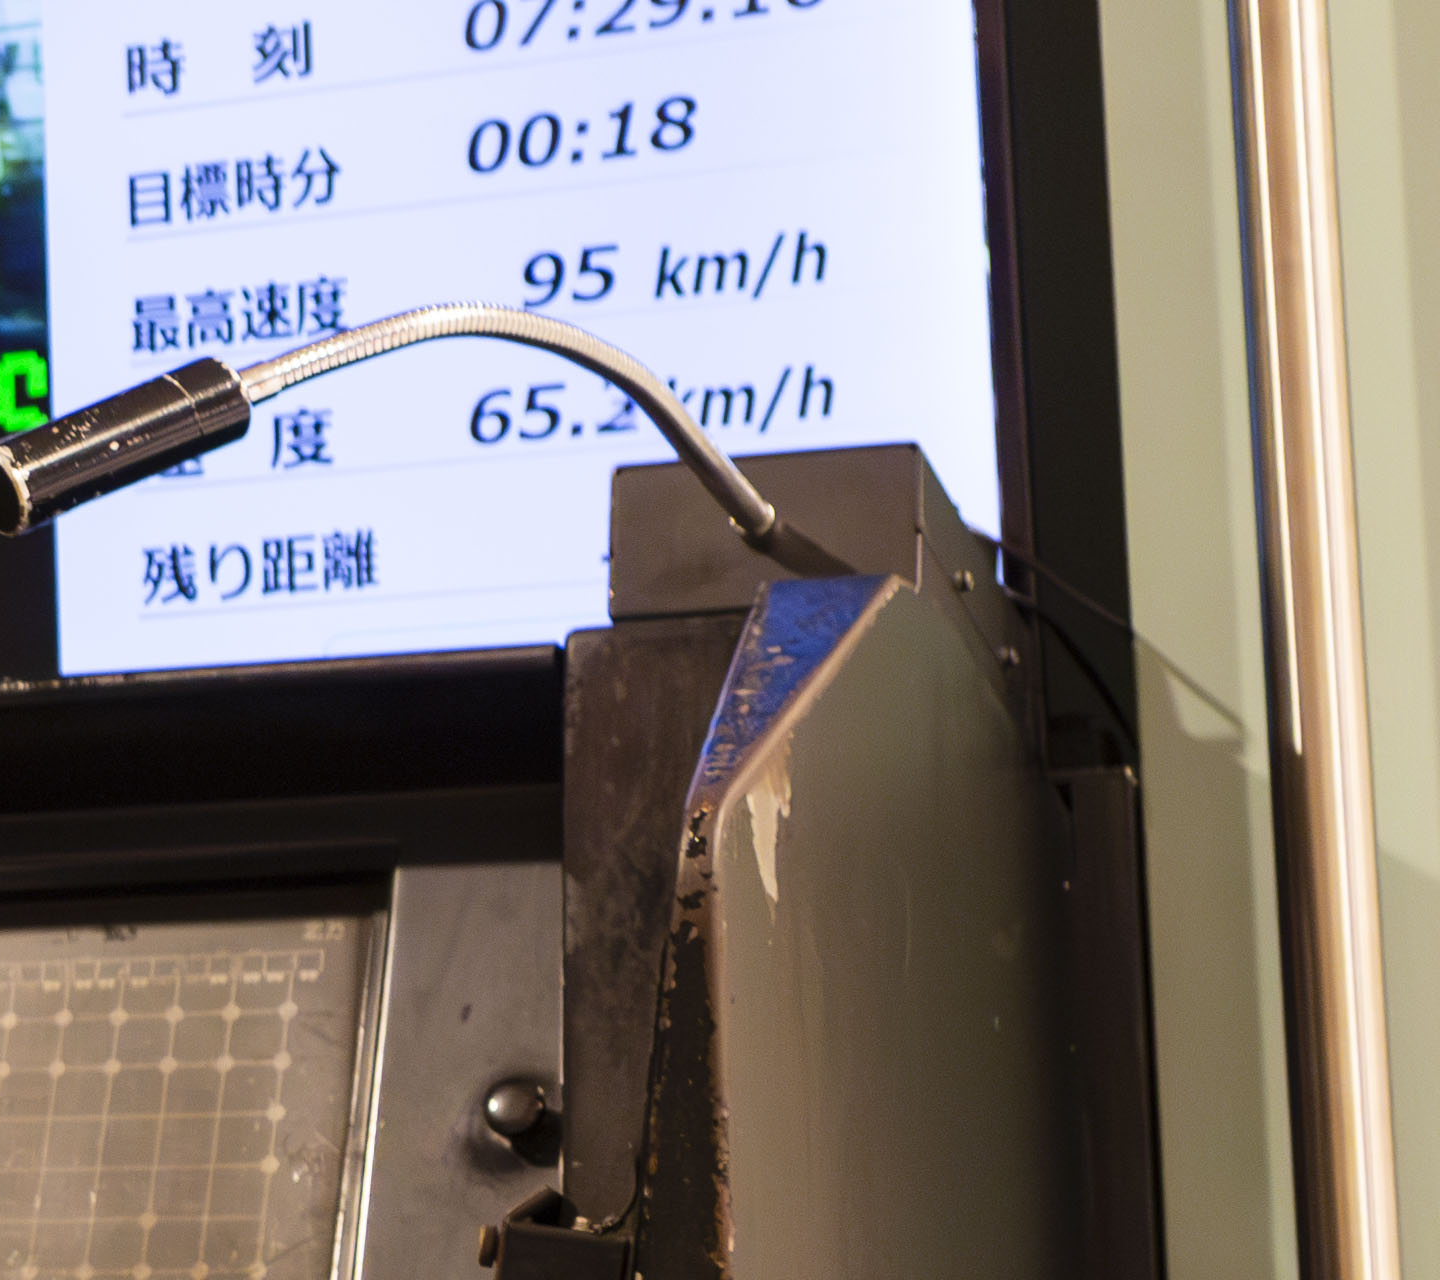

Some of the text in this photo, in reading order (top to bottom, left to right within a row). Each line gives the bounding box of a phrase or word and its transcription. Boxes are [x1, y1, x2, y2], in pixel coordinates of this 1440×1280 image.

[126, 19, 314, 96] 時刻
[466, 96, 697, 174] 00:18
[129, 146, 341, 227] 目標時分
[521, 231, 829, 310] 95 km/h
[133, 273, 348, 352] 最高速度
[141, 528, 379, 606] 残り距離
